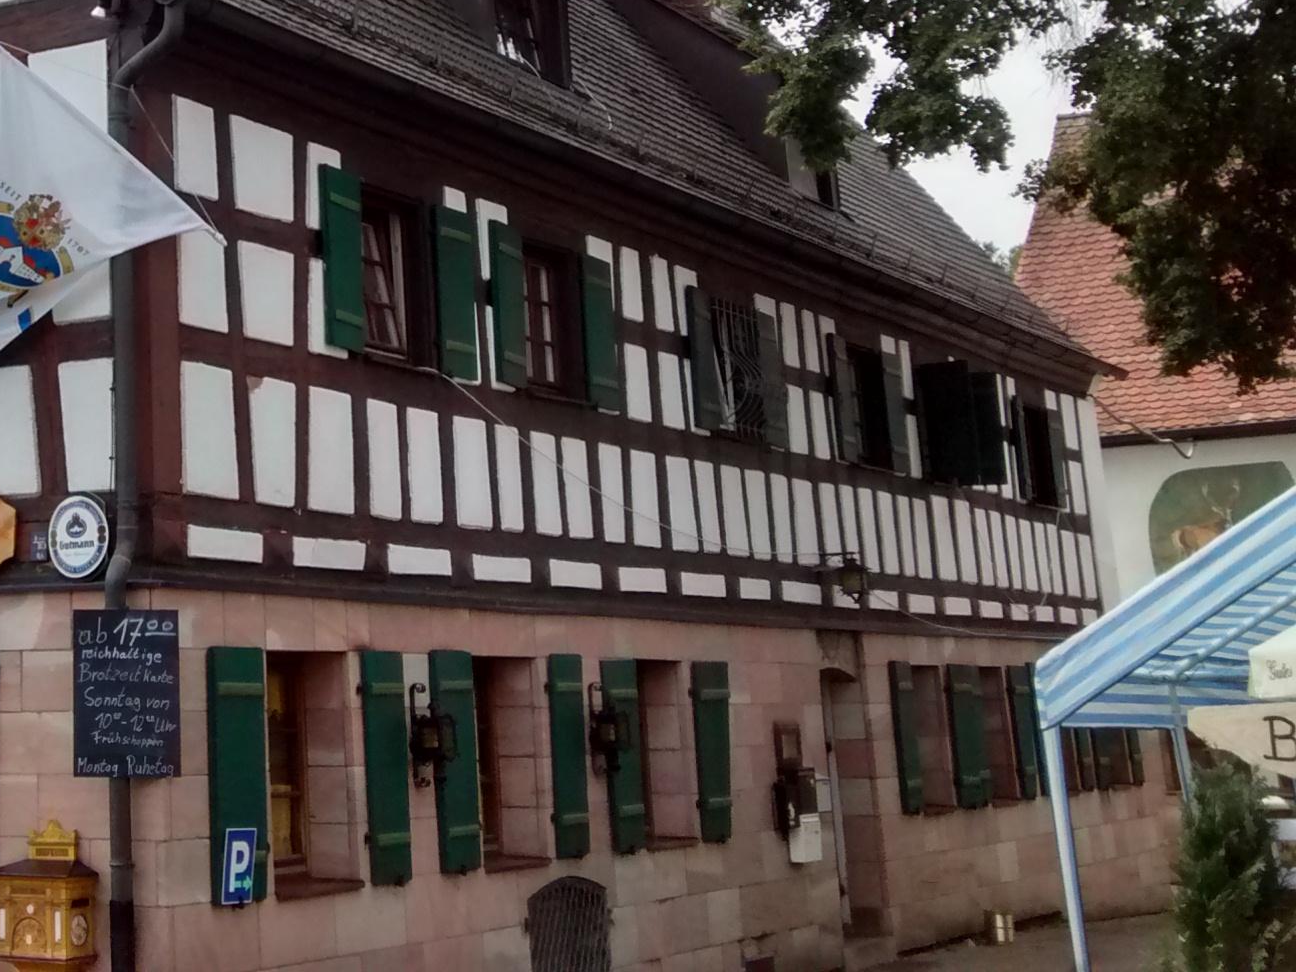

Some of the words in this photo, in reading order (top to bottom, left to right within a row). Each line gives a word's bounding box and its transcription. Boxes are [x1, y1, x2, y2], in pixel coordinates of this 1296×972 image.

[0, 181, 22, 201] SEIT
[78, 616, 108, 645] ab
[84, 686, 141, 712] Sonntag
[146, 697, 170, 711] von
[77, 756, 119, 778] Montag
[126, 754, 175, 778] Ruhetag
[229, 840, 251, 893] P
